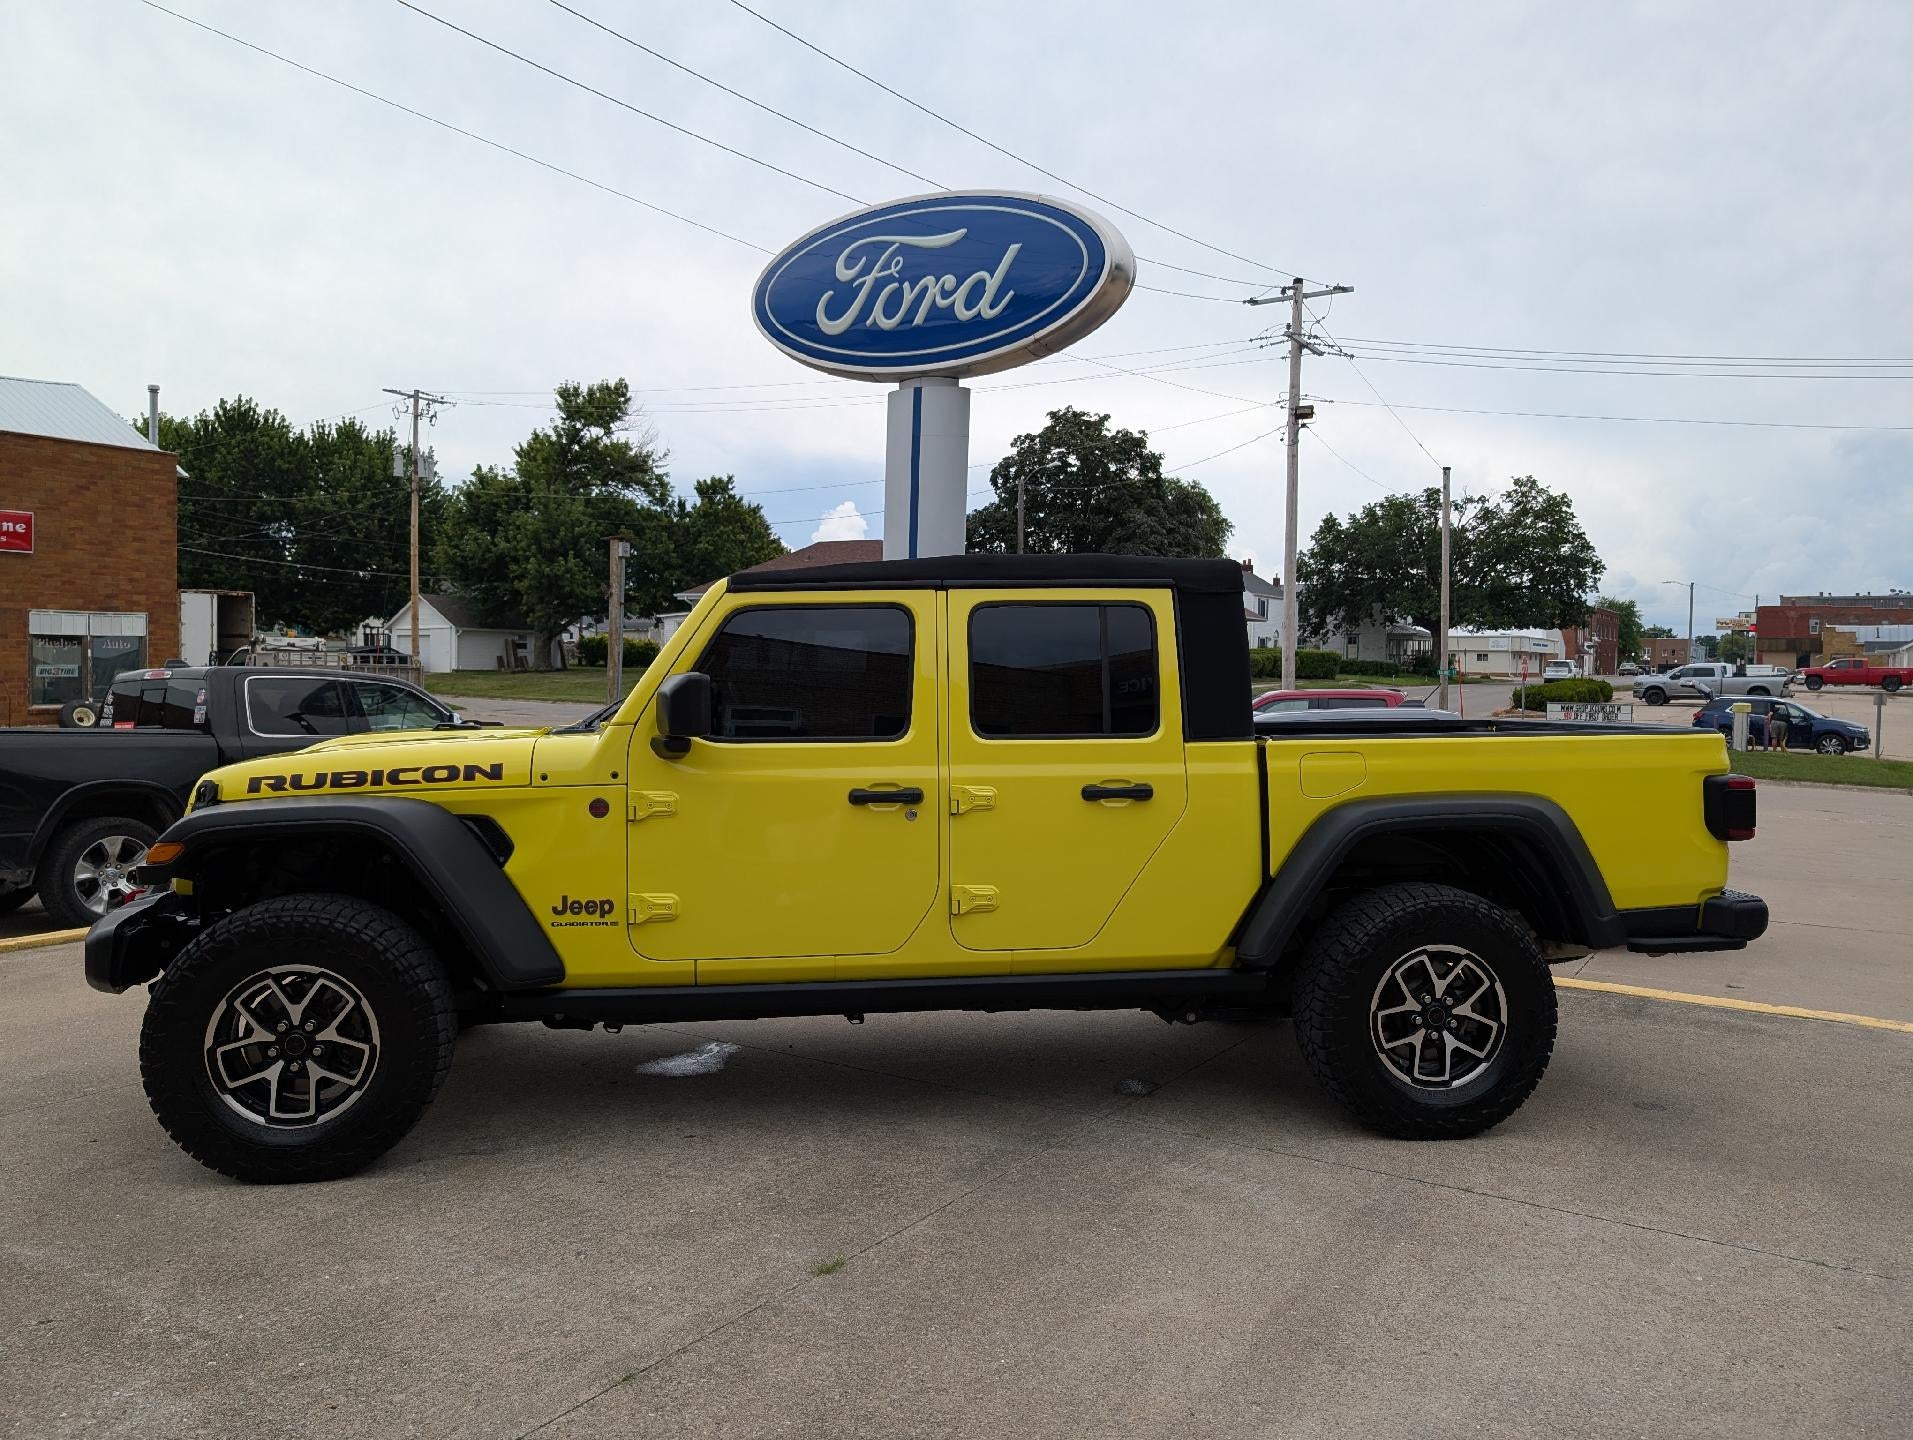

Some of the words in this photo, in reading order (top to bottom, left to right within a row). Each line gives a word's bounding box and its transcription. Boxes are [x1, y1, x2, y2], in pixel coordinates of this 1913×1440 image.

[816, 228, 1023, 335] Ford
[102, 639, 131, 649] Auto
[246, 762, 504, 794] RUBICON
[551, 894, 615, 919] Jeep
